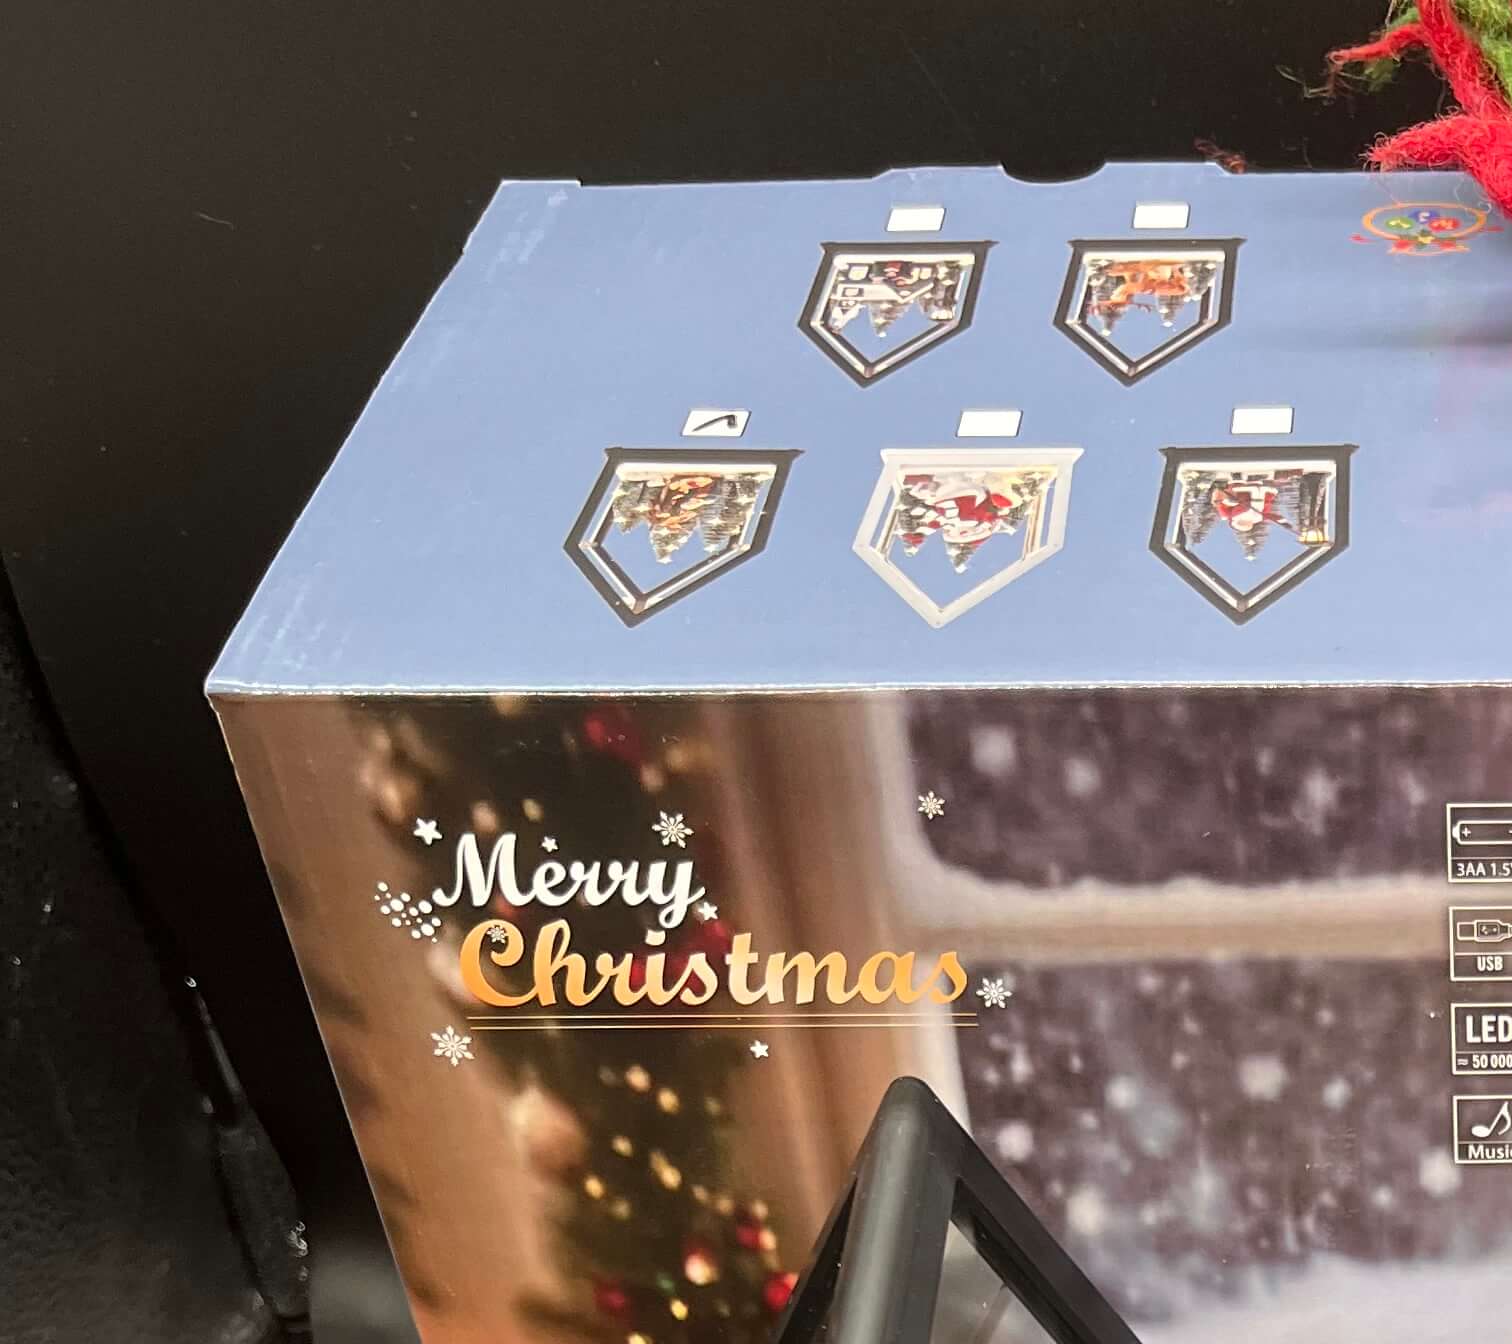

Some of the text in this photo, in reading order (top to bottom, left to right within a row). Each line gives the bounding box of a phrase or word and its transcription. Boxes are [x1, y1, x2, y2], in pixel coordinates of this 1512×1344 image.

[432, 832, 705, 929] Merry
[1456, 862, 1486, 876] 3AA
[459, 918, 968, 1007] Christmas
[1477, 956, 1503, 972] USB
